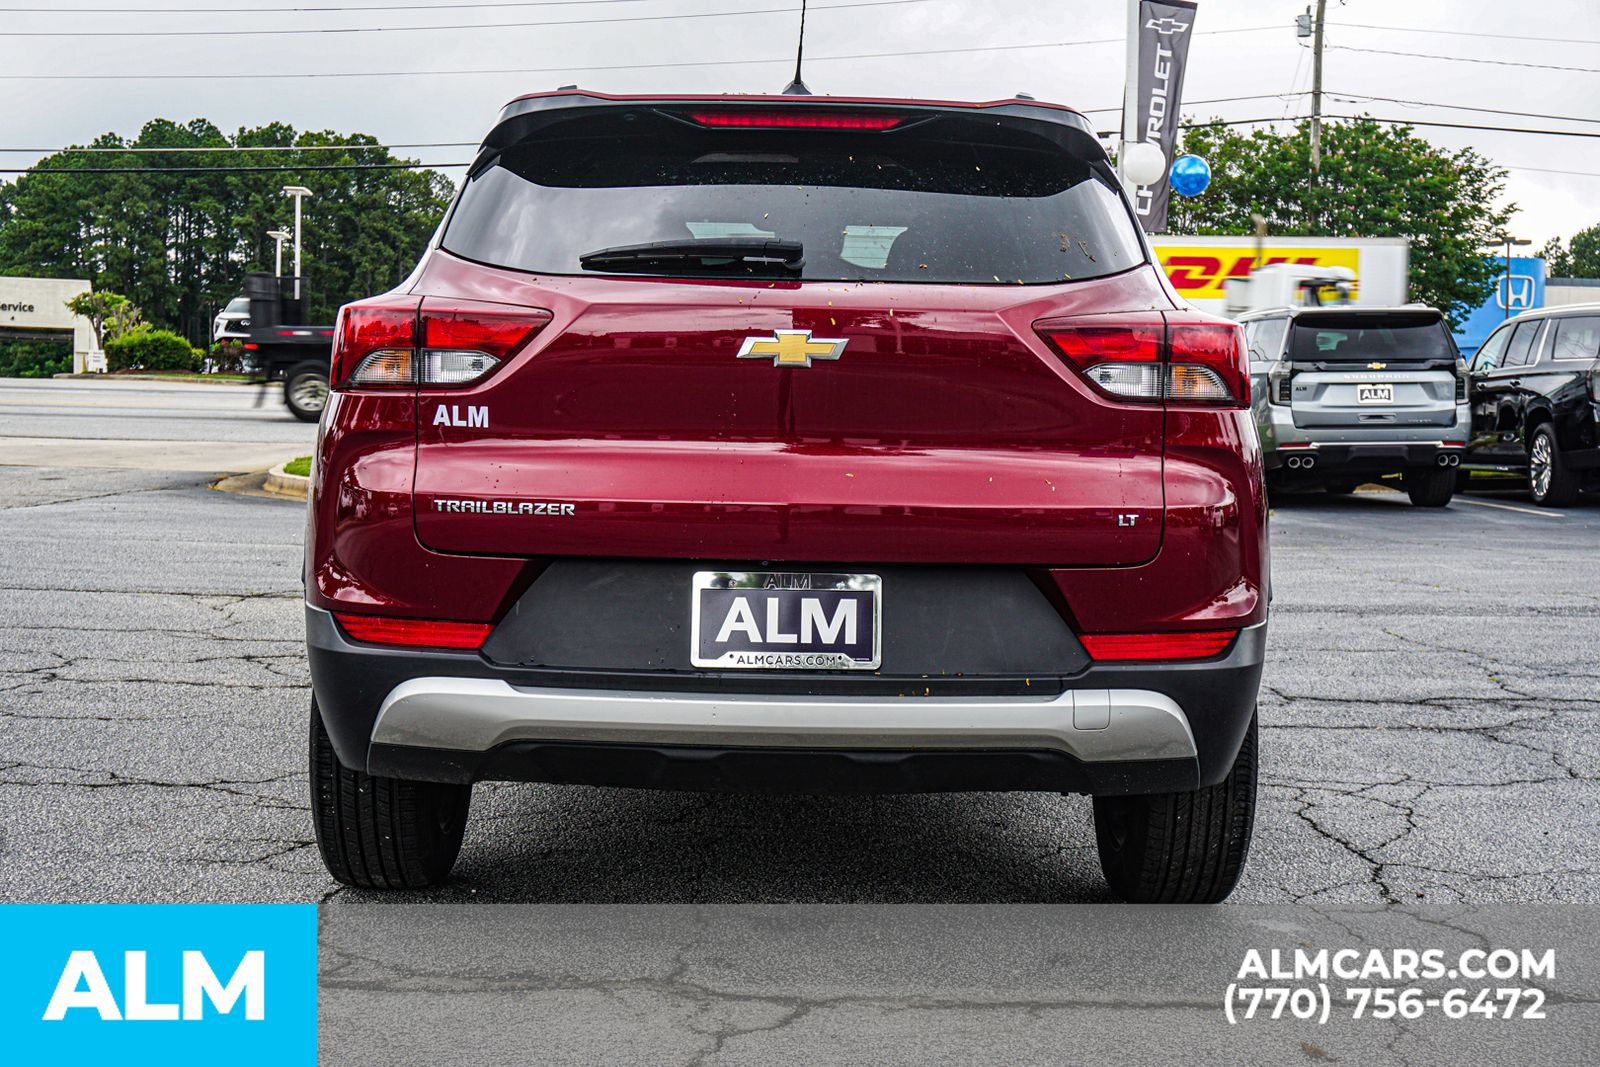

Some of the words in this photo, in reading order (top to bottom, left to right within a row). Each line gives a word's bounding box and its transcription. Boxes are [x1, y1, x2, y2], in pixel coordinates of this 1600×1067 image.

[1136, 43, 1172, 215] CHROLET
[0, 301, 35, 313] ervice
[1362, 389, 1389, 399] ALM
[432, 404, 489, 428] ALM
[434, 500, 575, 516] TRAILBLAZER
[1118, 514, 1140, 527] LT
[763, 573, 811, 590] ALM
[715, 597, 857, 645] ALM
[736, 655, 836, 666] ALMCARS.COM
